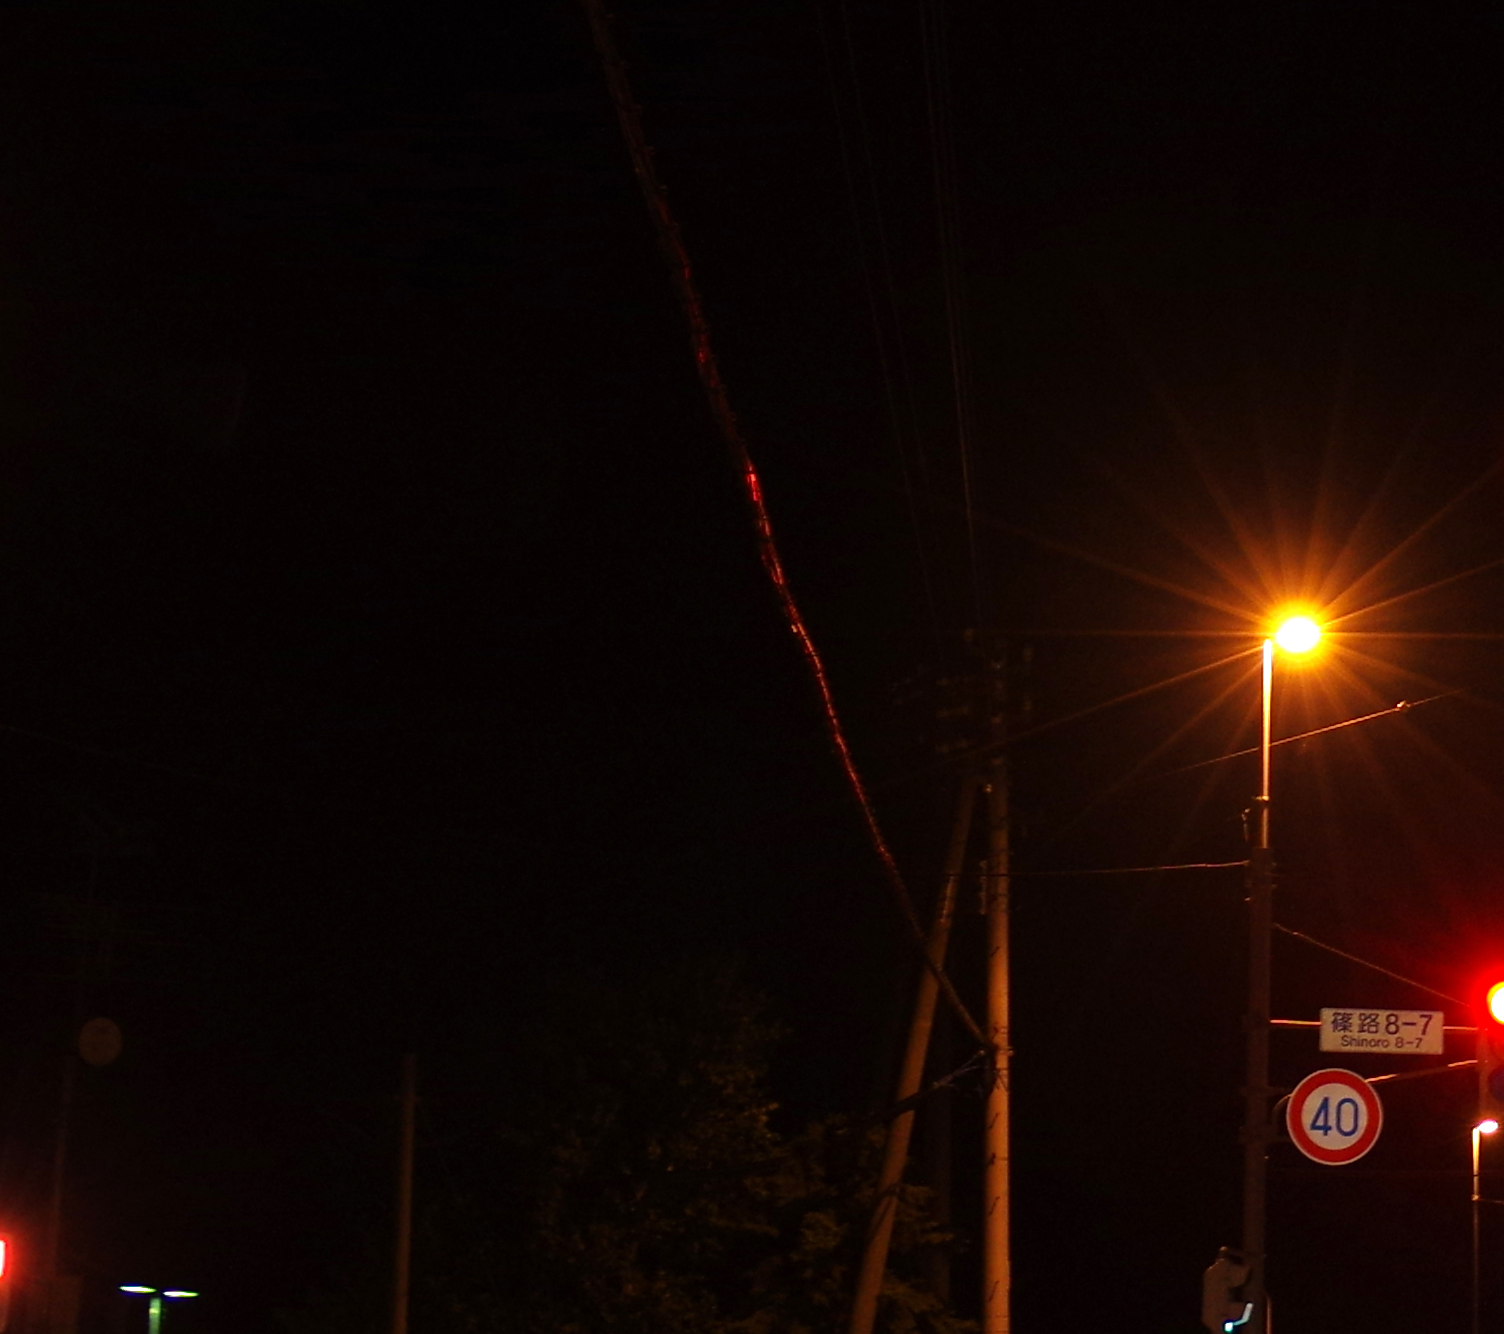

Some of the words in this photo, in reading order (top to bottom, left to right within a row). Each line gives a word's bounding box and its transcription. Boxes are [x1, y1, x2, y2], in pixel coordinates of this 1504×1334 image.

[1340, 1034, 1390, 1049] Shinoro
[1394, 1036, 1424, 1049] 8-7
[1309, 1096, 1360, 1137] 40
